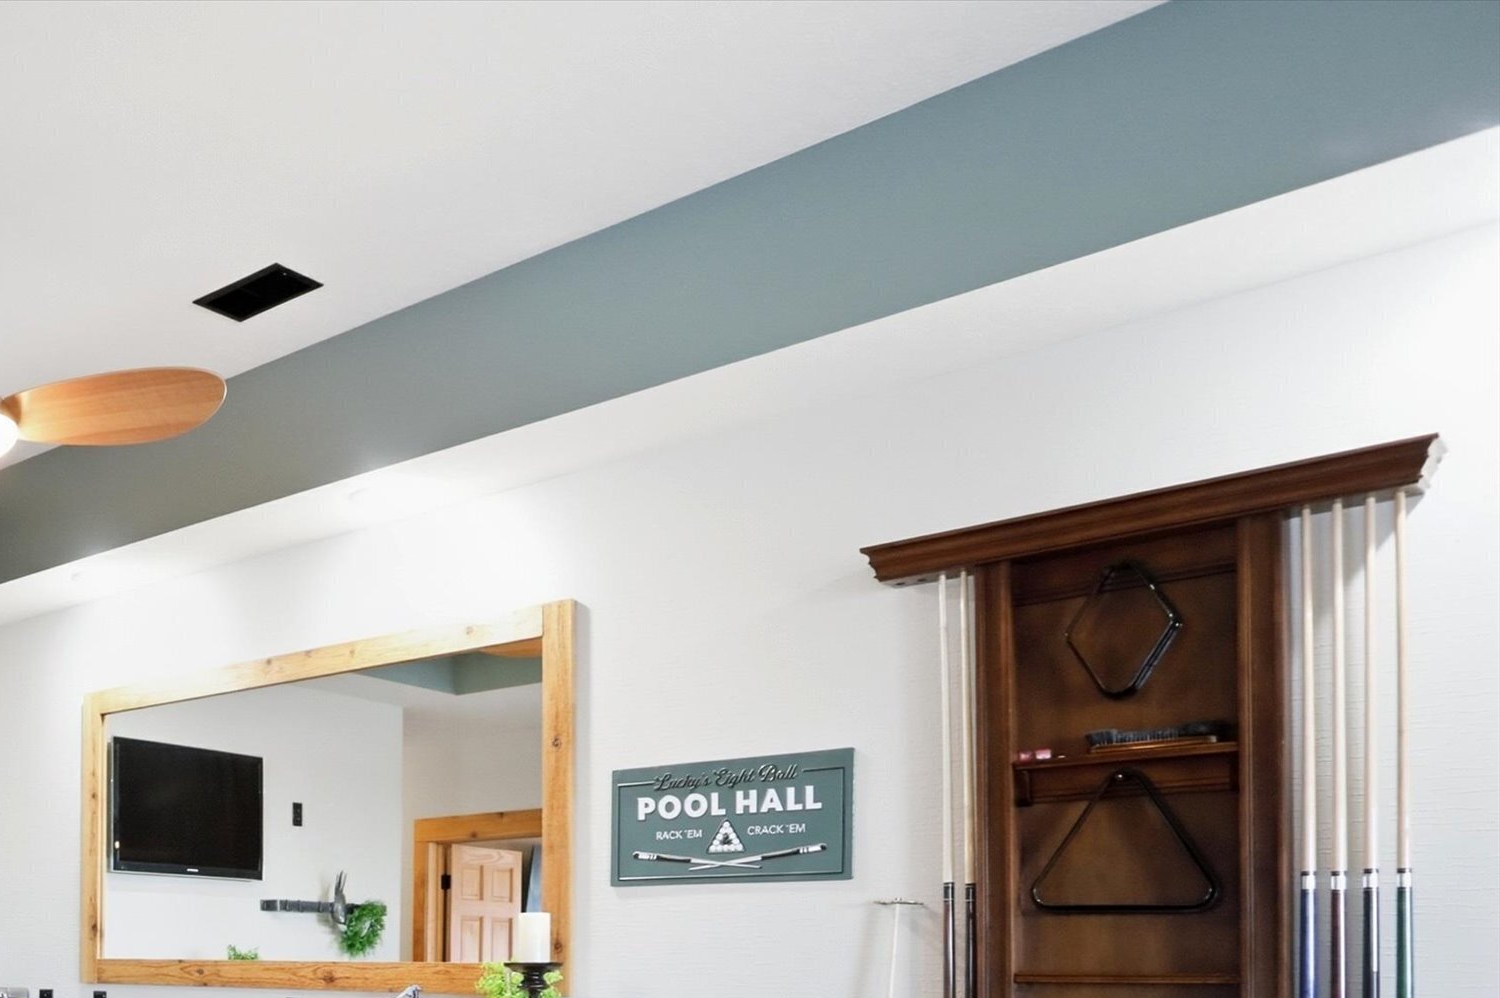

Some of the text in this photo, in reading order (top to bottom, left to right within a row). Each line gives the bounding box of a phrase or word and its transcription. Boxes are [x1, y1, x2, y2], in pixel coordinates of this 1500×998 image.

[653, 763, 798, 793] Lucky's Eight Ball
[637, 785, 823, 821] POOL HALL
[655, 830, 683, 841] RACK
[747, 825, 784, 836] CRACK
